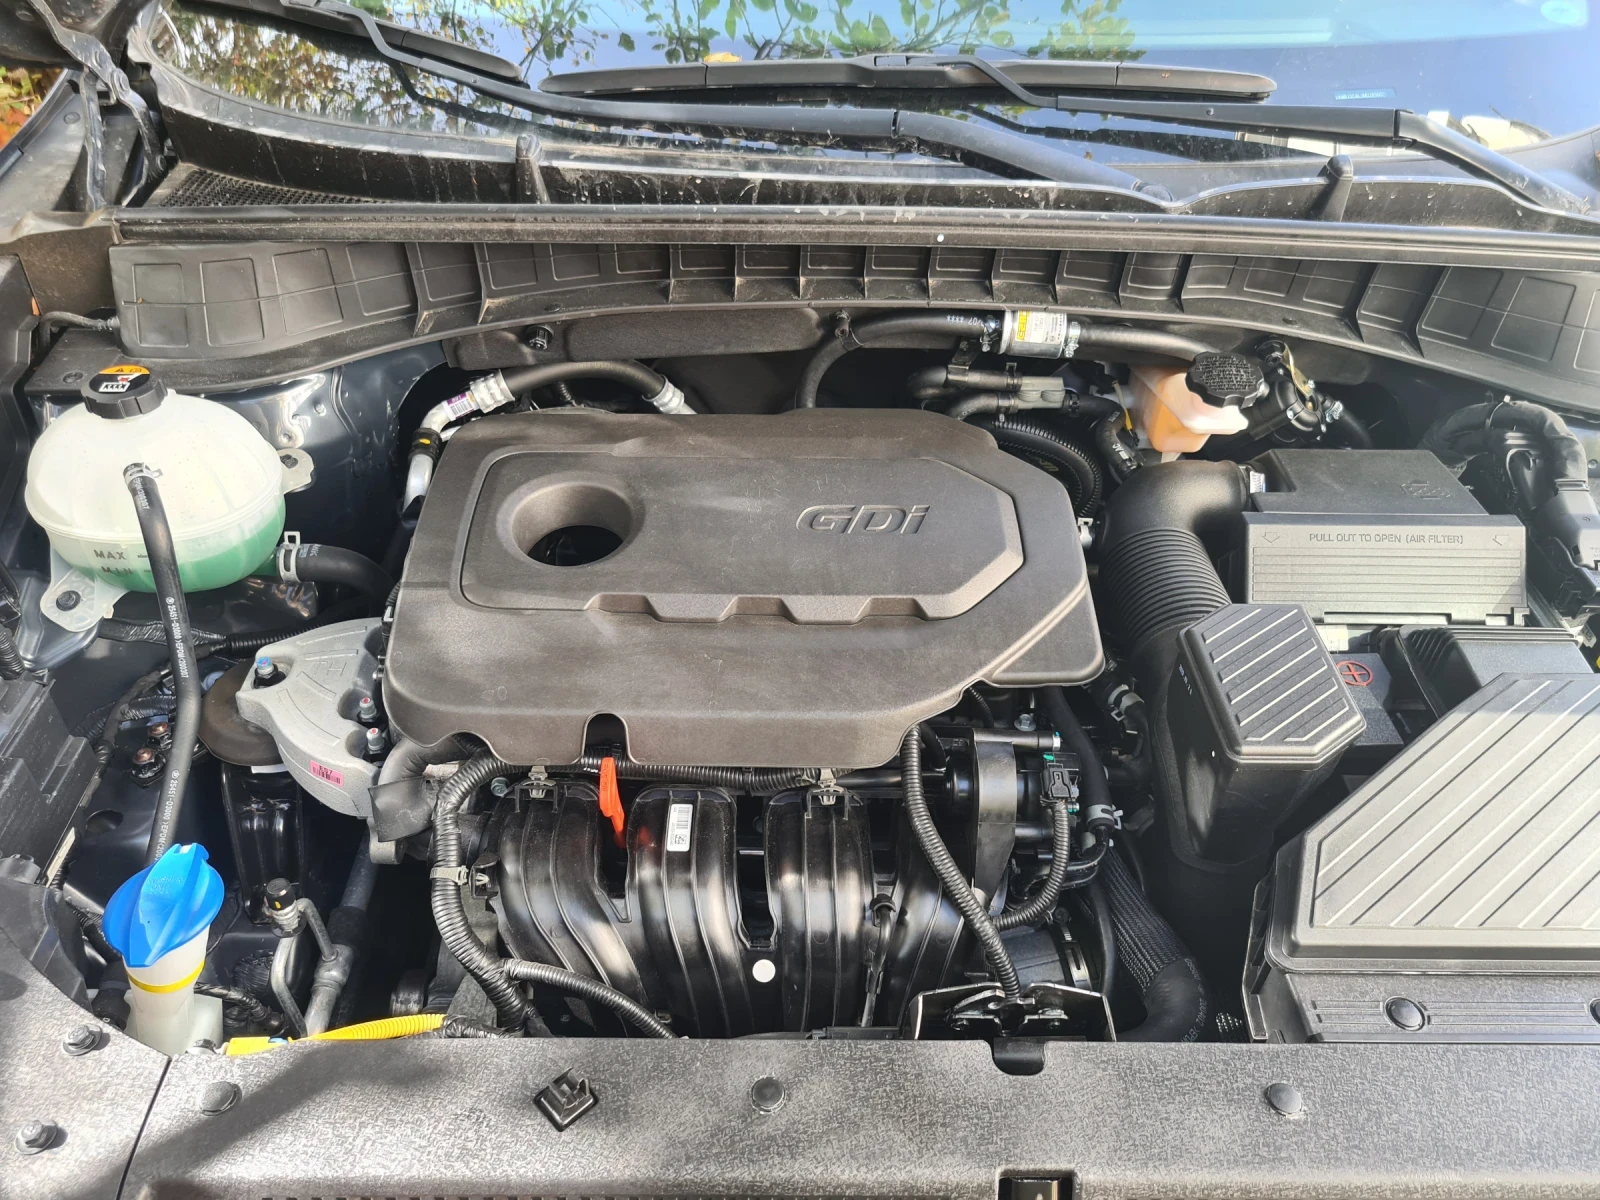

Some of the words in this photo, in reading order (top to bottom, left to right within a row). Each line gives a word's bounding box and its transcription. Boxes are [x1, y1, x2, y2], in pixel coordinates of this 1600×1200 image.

[796, 504, 931, 534] GDi
[1309, 533, 1334, 542] PULL
[1336, 533, 1357, 542] OUT
[1359, 533, 1372, 542] TO
[1374, 534, 1402, 543] OPEN
[1406, 534, 1426, 544] (AIR
[1428, 534, 1464, 544] FILTER)
[93, 549, 126, 560] MAX
[101, 566, 132, 575] MIN
